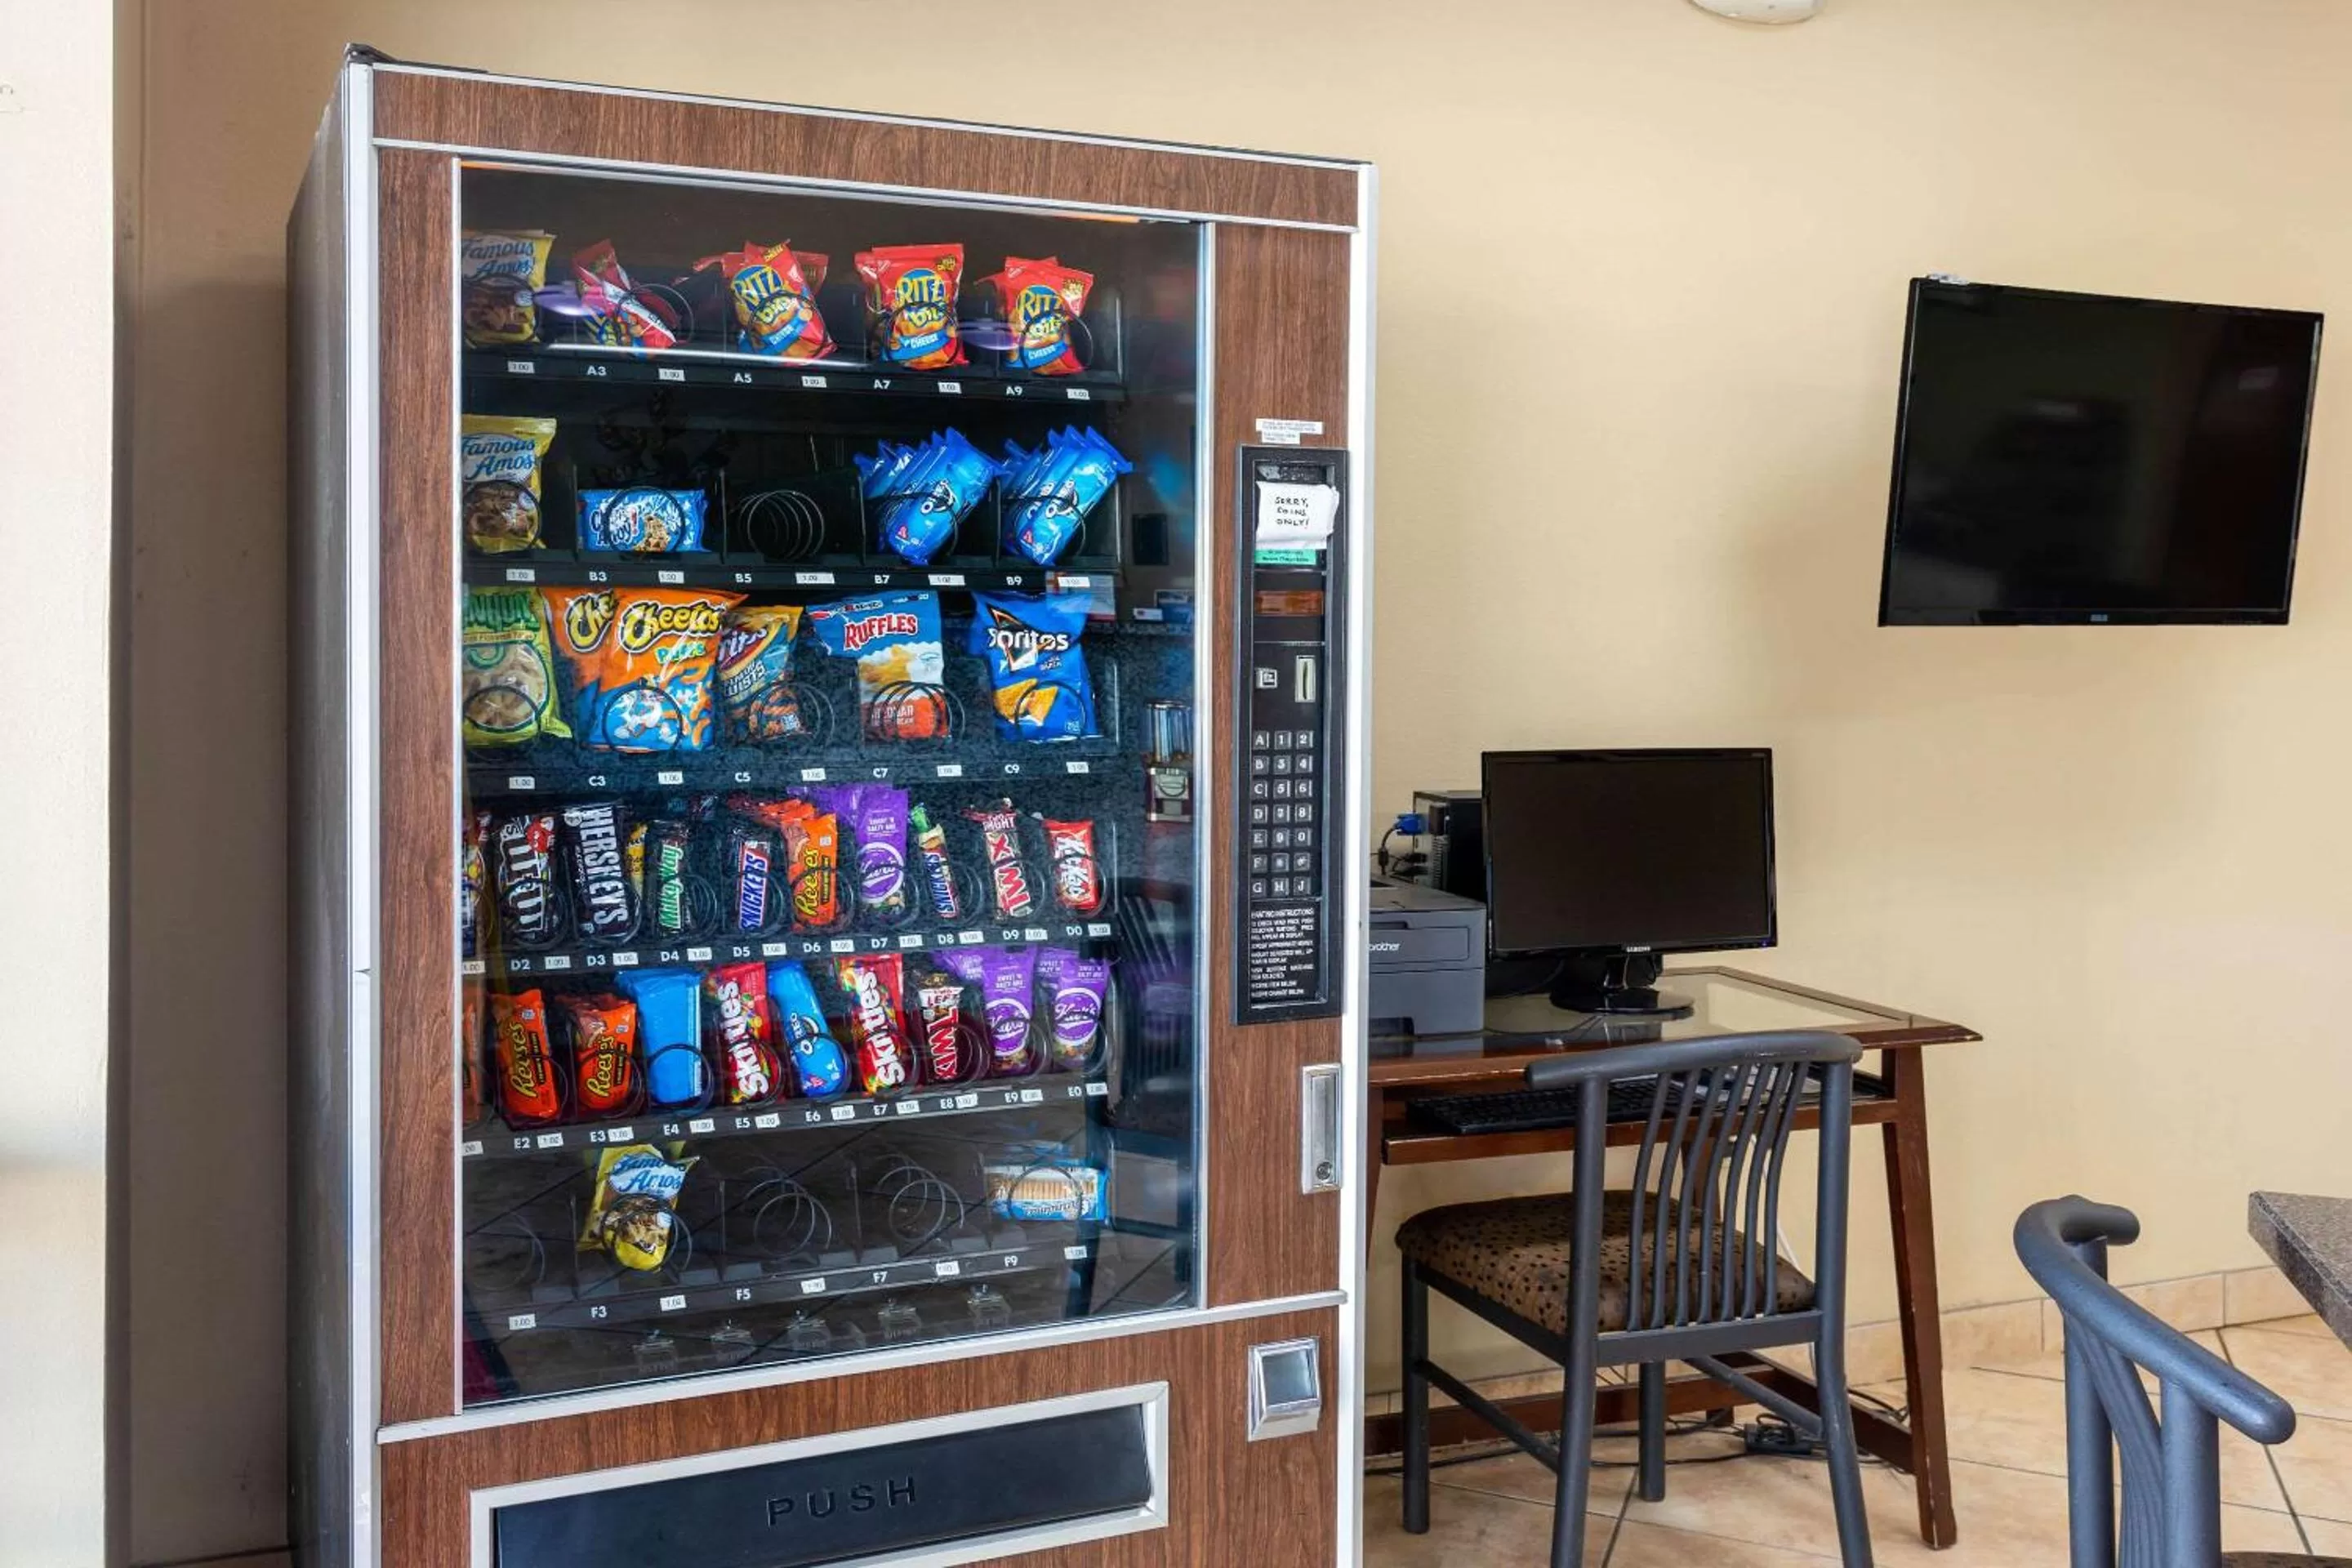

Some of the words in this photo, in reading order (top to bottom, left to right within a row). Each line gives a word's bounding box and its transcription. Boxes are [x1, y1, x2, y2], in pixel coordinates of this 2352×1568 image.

[731, 266, 783, 311] RITZ
[897, 275, 948, 307] RITZ
[1017, 288, 1063, 327] RITZ
[587, 365, 607, 376] A3
[734, 372, 751, 383] A5
[874, 379, 891, 390] A7
[1006, 385, 1022, 395] A9
[461, 438, 535, 455] Famous
[466, 455, 532, 480] Amos
[589, 571, 607, 581] B3
[735, 573, 751, 583] B5
[874, 574, 889, 584] B7
[1006, 575, 1022, 586] B9
[620, 601, 720, 652] Cheetos
[844, 613, 917, 650] RUFFLES
[1255, 734, 1263, 746] A
[1299, 734, 1307, 745] 2
[1004, 763, 1019, 773] C9
[1255, 759, 1263, 770] B
[1299, 759, 1307, 769] 4
[734, 772, 751, 782] C5
[873, 768, 888, 778] C7
[589, 775, 606, 786] C3
[1254, 783, 1263, 795] C
[1277, 783, 1285, 794] 5
[1299, 783, 1307, 794] 6
[1254, 808, 1263, 819] D
[1299, 807, 1306, 817] 8
[1254, 833, 1263, 844] E
[579, 804, 629, 925] HERSHEY'S
[661, 844, 684, 880] Way
[1253, 882, 1262, 893] G
[1274, 881, 1284, 892] H
[1298, 880, 1304, 891] J
[740, 853, 768, 931] SNICKERS
[658, 880, 684, 929] Milky
[938, 933, 954, 944] D8
[1003, 929, 1019, 940] D9
[803, 942, 821, 952] D6
[871, 938, 888, 948] D7
[660, 951, 679, 962] D4
[733, 947, 750, 957] D5
[510, 959, 531, 970] D2
[587, 954, 606, 966] D3
[859, 972, 906, 1086] Skittles
[717, 981, 769, 1096] Skittles
[1004, 1092, 1018, 1102] E9
[940, 1098, 954, 1109] E8
[873, 1103, 888, 1116] E7
[805, 1111, 821, 1121] E6
[735, 1117, 750, 1129] E5
[663, 1124, 679, 1135] E4
[590, 1130, 606, 1142] E3
[514, 1137, 530, 1148] E2
[1004, 1255, 1018, 1267] F9
[873, 1272, 887, 1283] F7
[737, 1288, 751, 1300] F5
[591, 1306, 607, 1318] F3
[766, 1476, 915, 1526] PUSH
